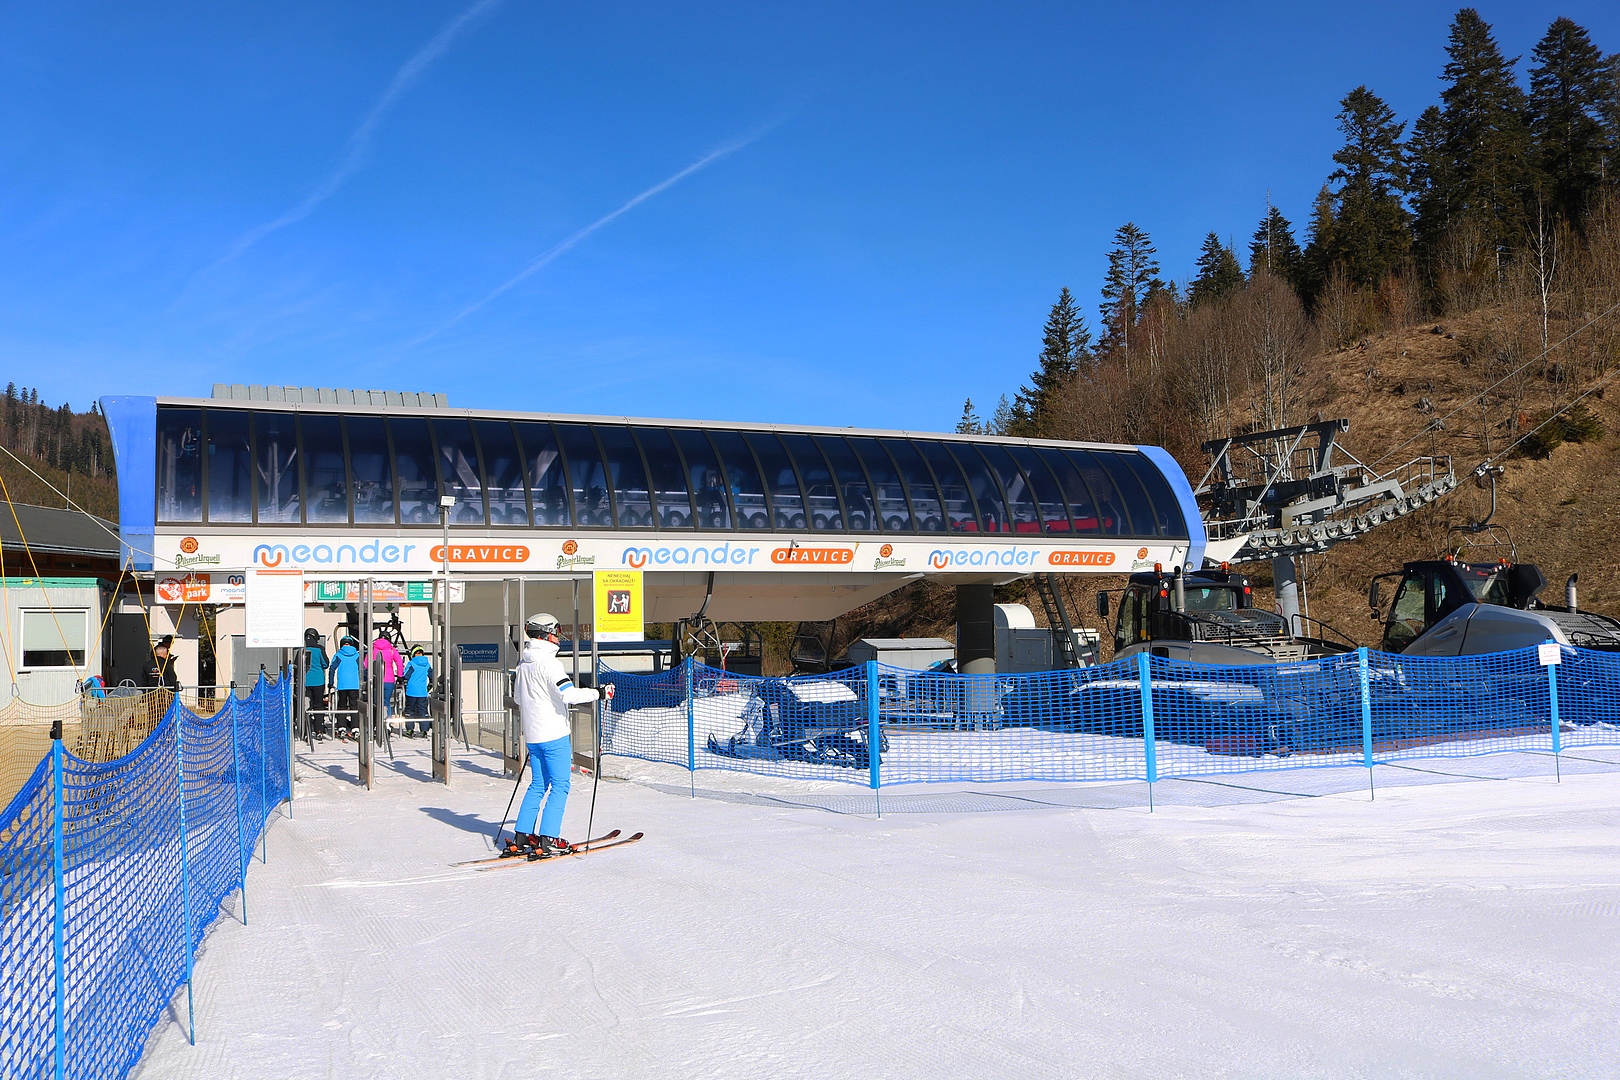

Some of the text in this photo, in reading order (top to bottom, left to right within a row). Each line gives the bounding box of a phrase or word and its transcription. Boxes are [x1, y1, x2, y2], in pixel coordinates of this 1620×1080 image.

[253, 539, 416, 567] meander
[436, 548, 524, 560] ORAVICE
[621, 542, 760, 568] meander
[776, 550, 849, 562] ORAVICE
[928, 546, 1041, 569] meander
[1053, 553, 1112, 564] ORAVICE
[175, 553, 220, 569] Pilsner Urquell
[185, 579, 207, 588] bike
[187, 588, 208, 599] park
